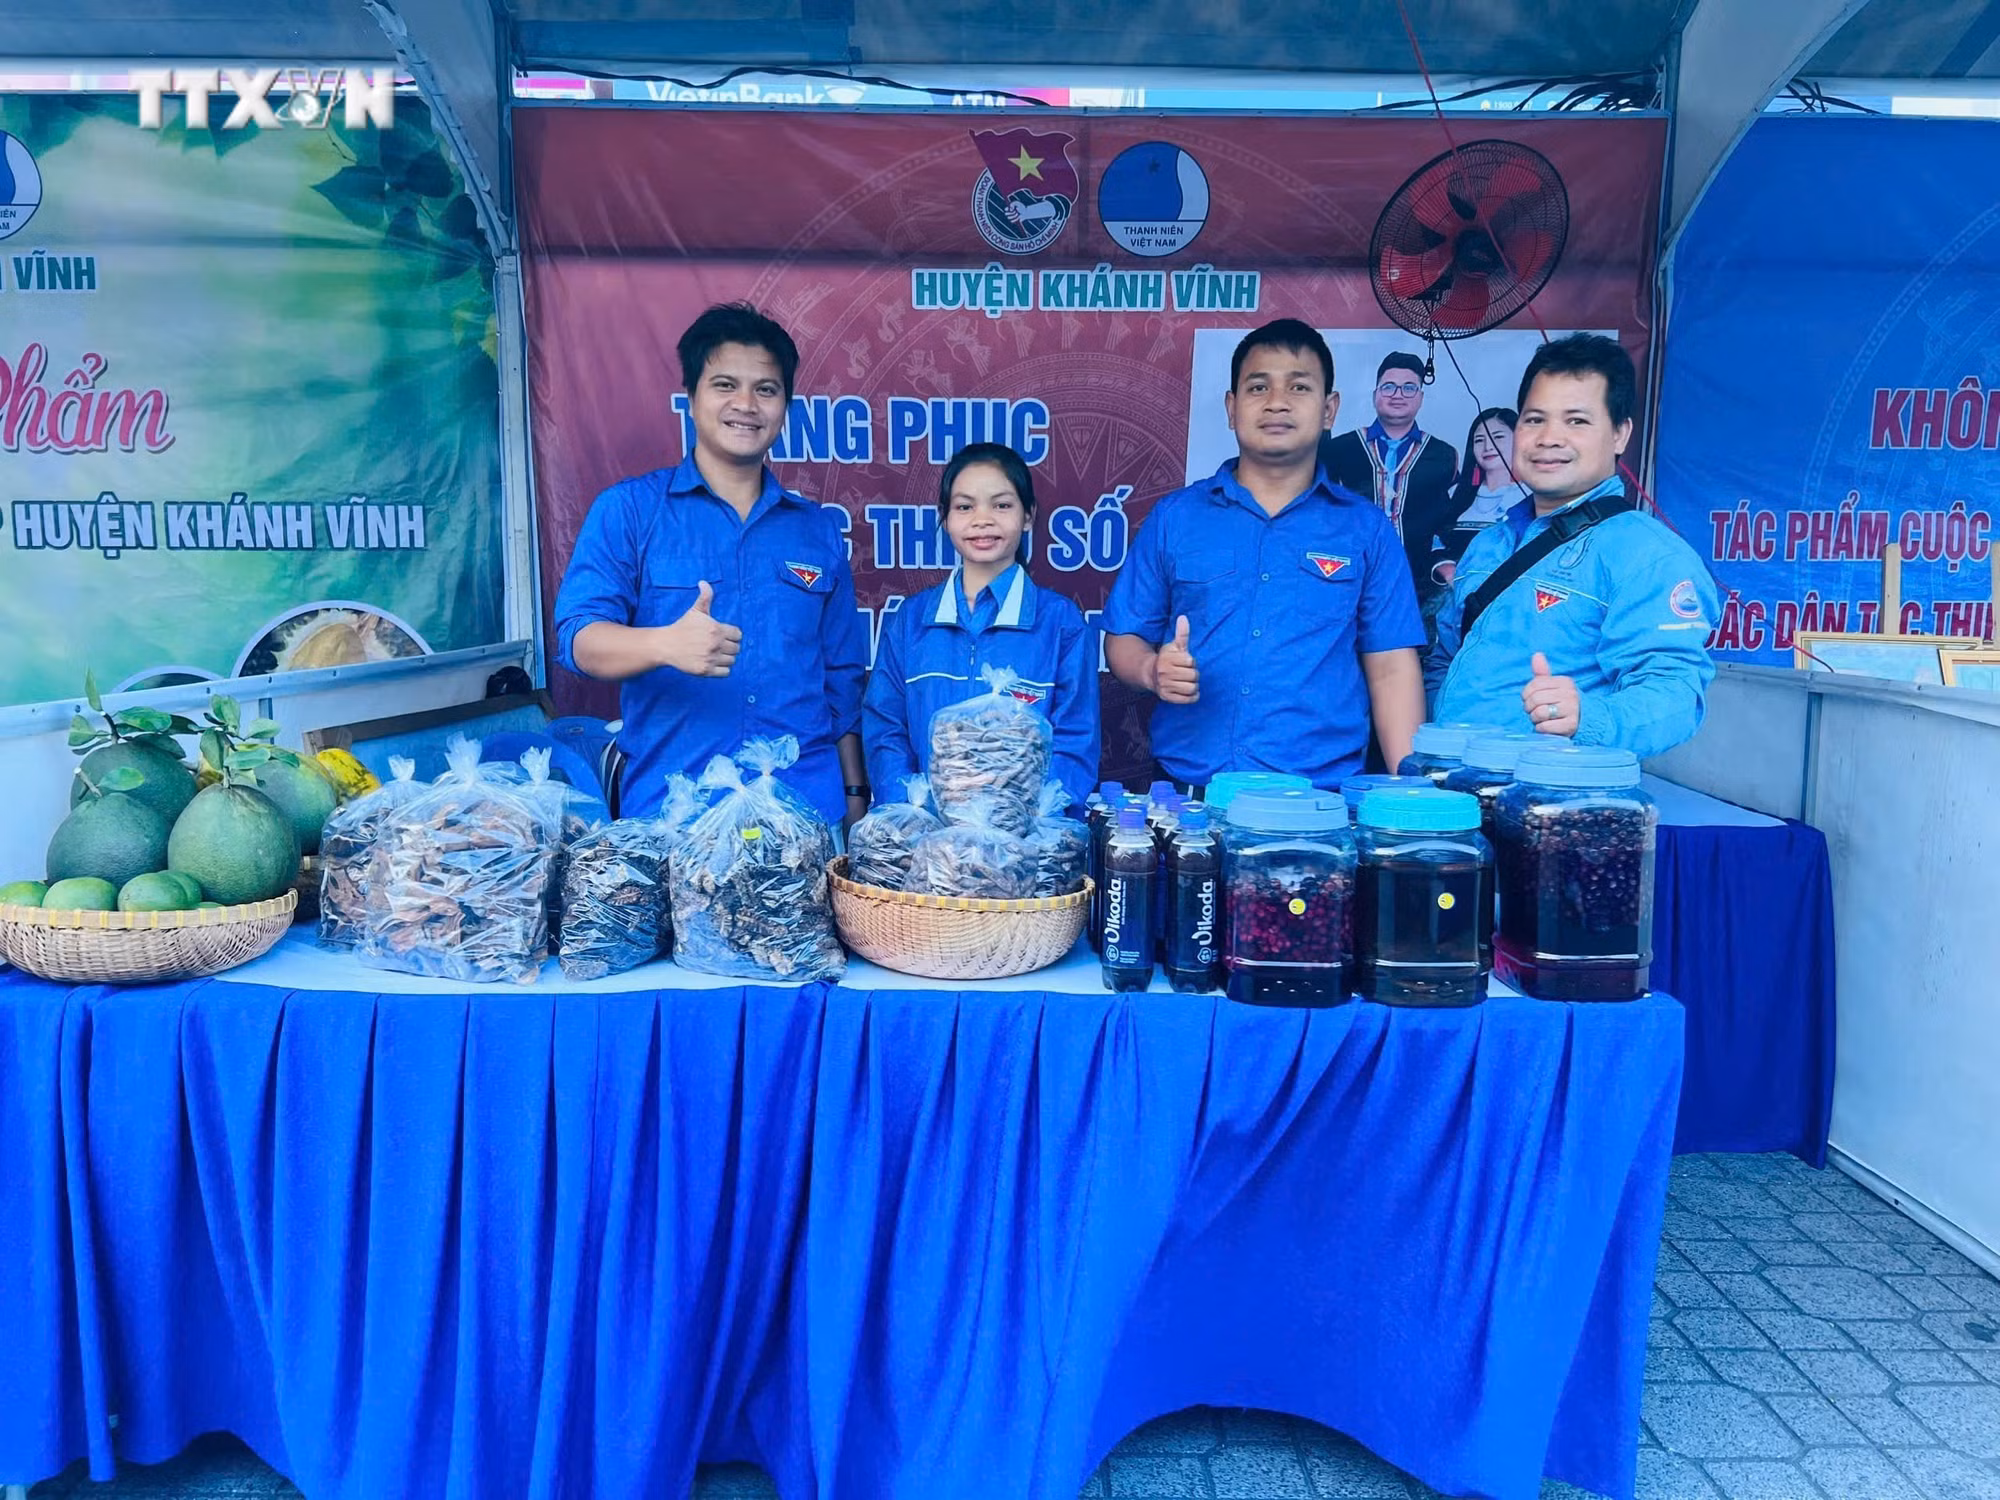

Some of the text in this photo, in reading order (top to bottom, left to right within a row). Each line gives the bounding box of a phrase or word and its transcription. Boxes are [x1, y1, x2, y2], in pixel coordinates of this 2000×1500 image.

[1123, 224, 1184, 236] THANH NIÊN
[1130, 236, 1177, 249] VIỆT NAM
[12, 249, 97, 291] VĨNH
[914, 264, 1259, 316] HUYỆN KHÁNH VĨNH
[13, 492, 157, 559] HUYỆN
[166, 492, 315, 549] KHÁNH
[325, 496, 426, 549] VĨNH
[1047, 484, 1134, 572] SỐ
[1710, 490, 1992, 572] TÁC PHẨM CUỘC
[1704, 590, 1767, 652] ÁC
